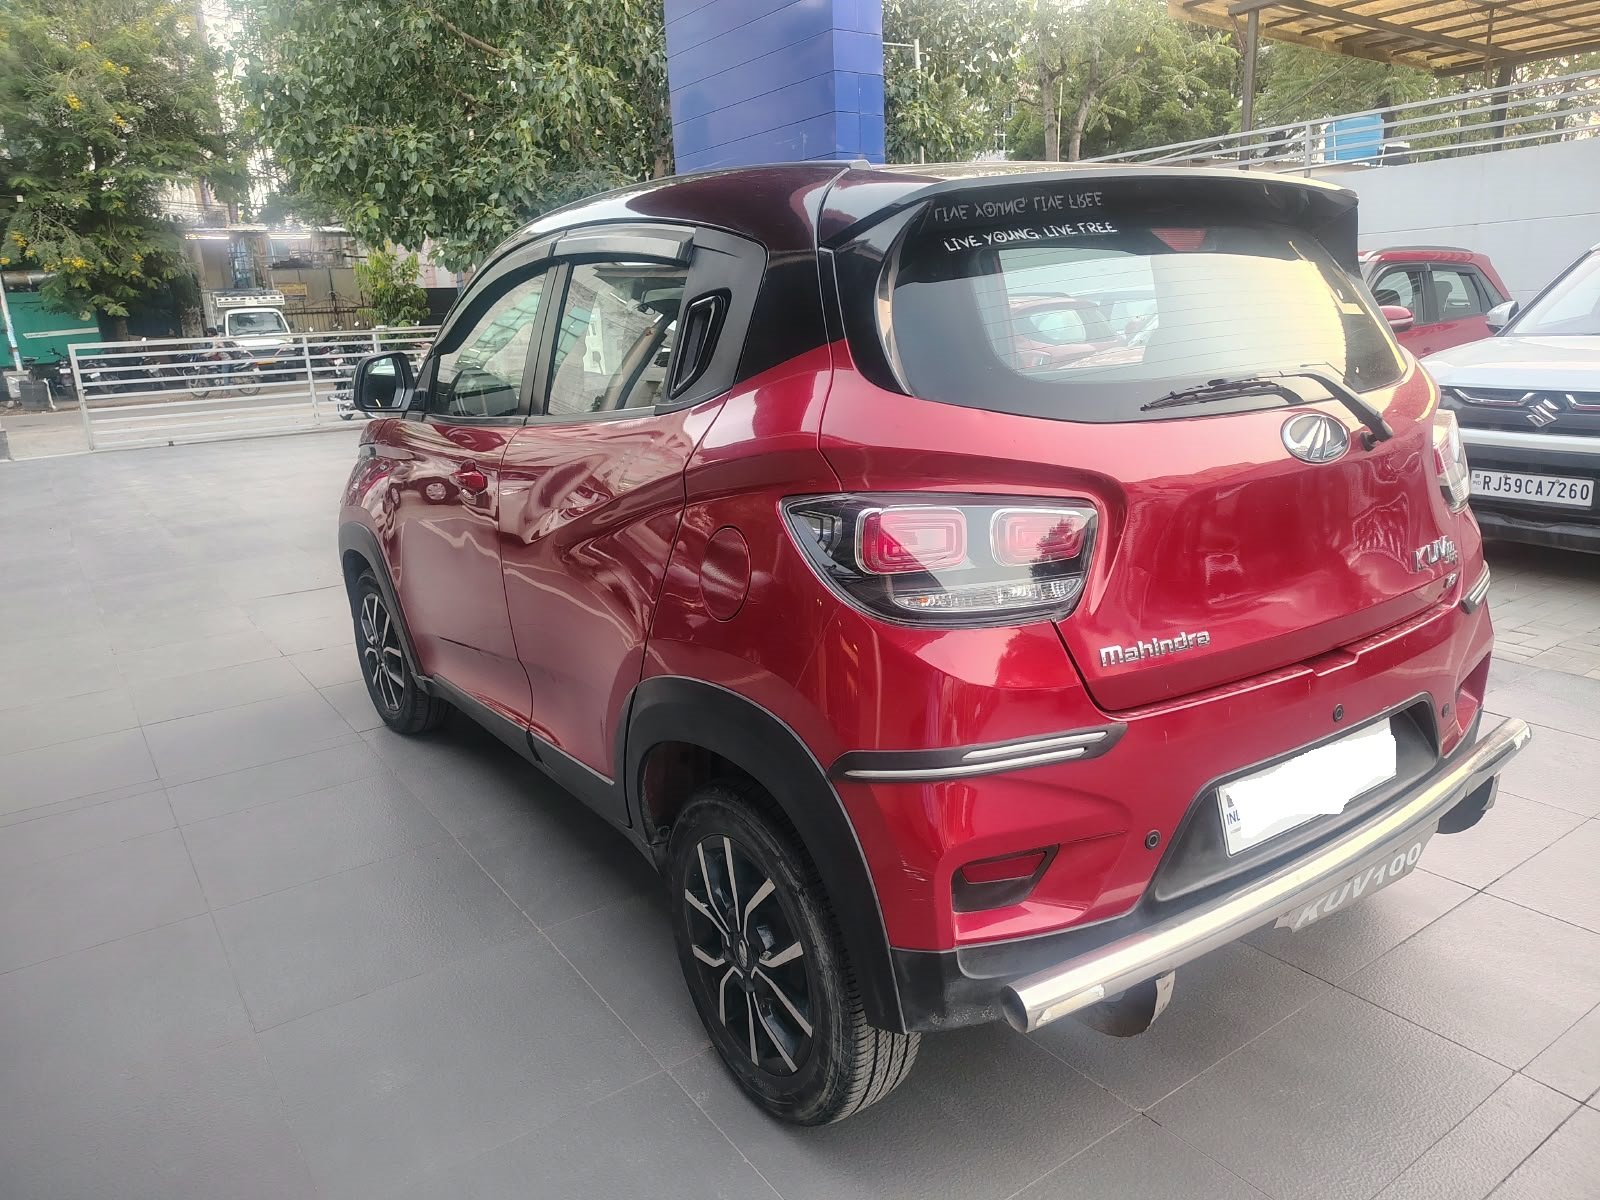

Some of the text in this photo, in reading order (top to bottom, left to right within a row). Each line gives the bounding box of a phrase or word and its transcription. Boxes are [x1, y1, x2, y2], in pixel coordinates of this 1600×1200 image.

[943, 235, 982, 253] LIVE
[1042, 224, 1078, 238] LIVE
[1077, 221, 1118, 234] FREE
[1482, 475, 1590, 501] RJ59CA7260
[1099, 630, 1212, 667] Mahindra
[1294, 842, 1423, 930] KUV100
